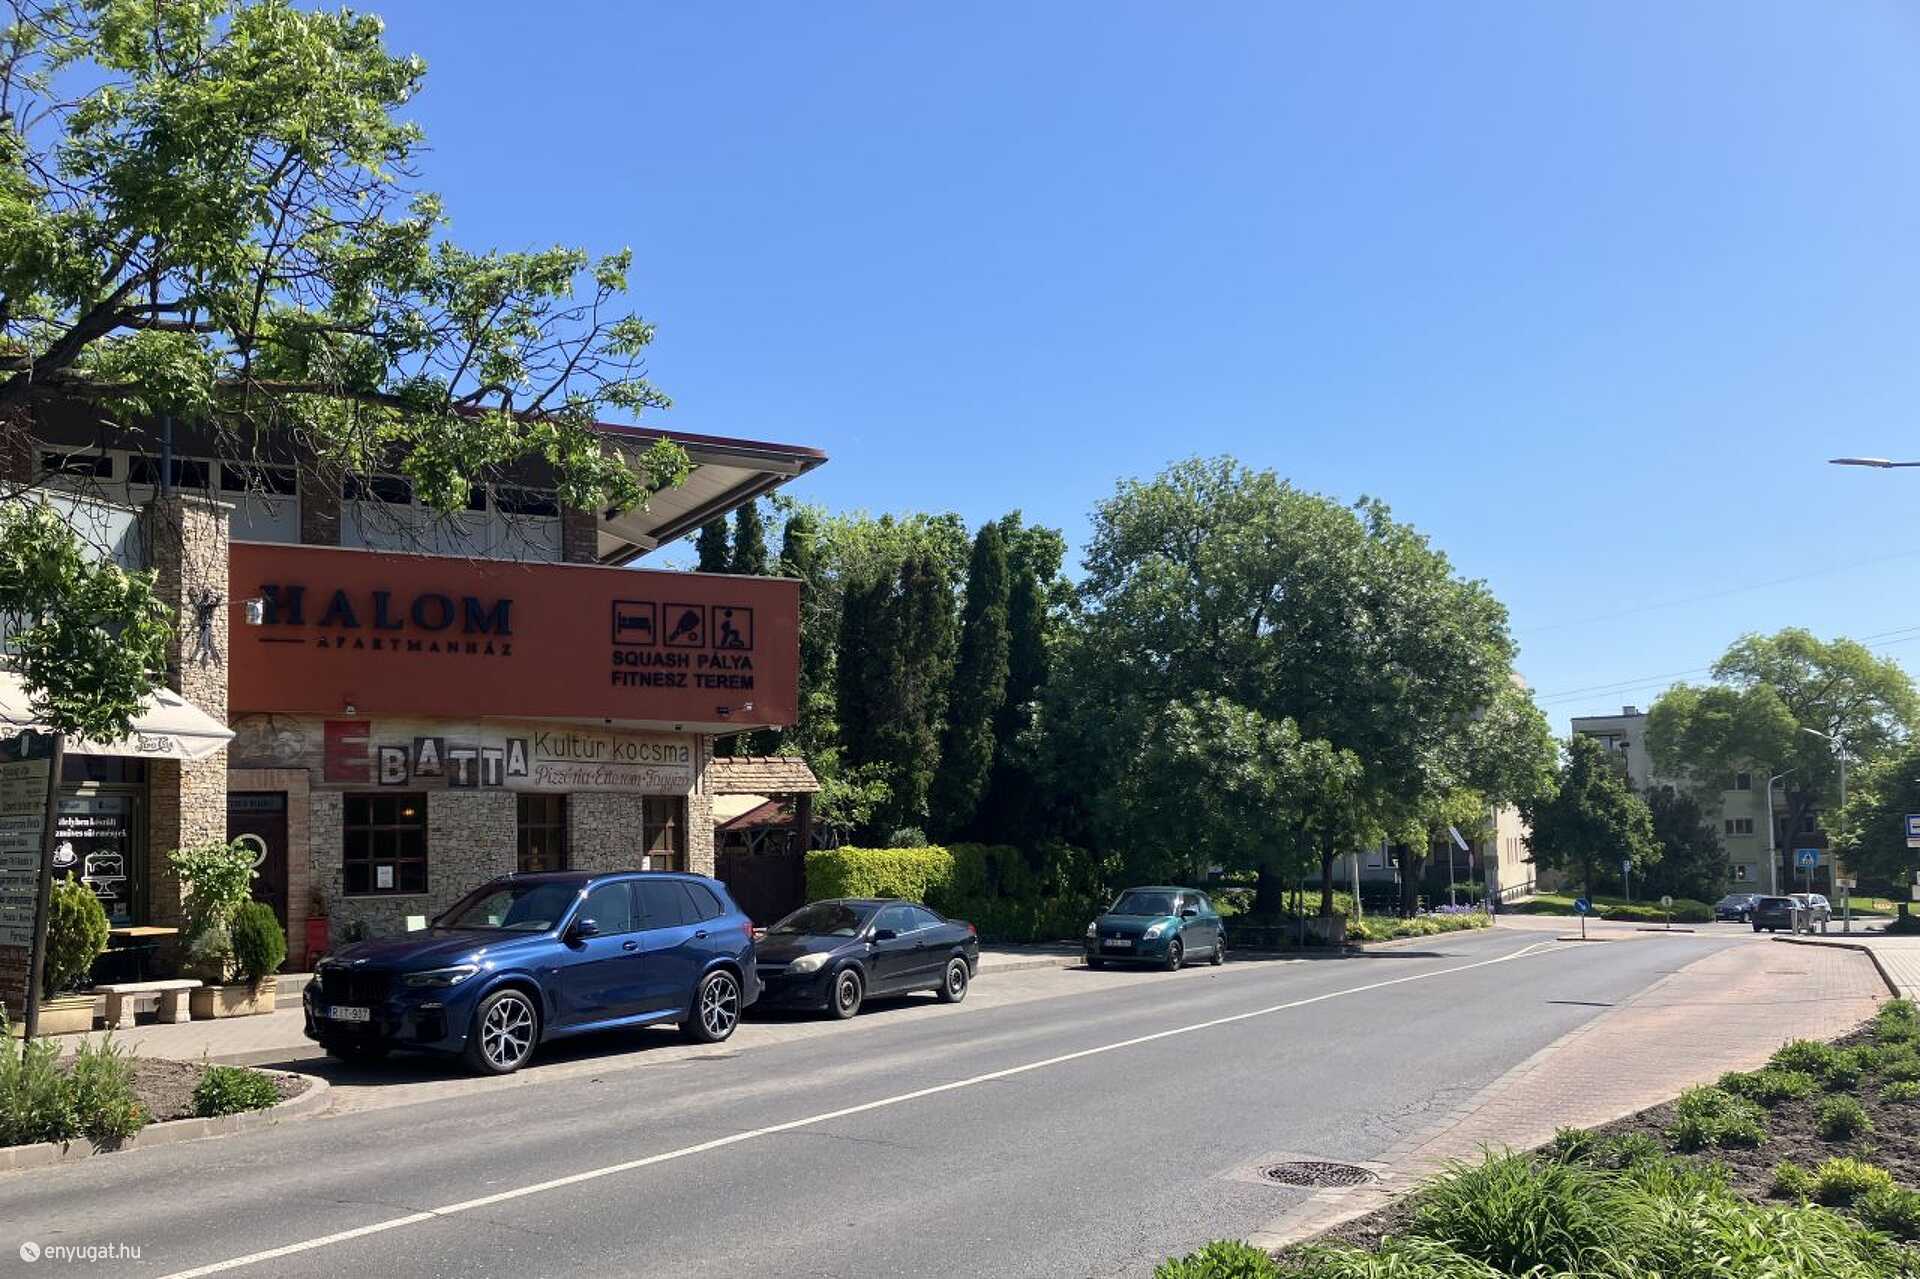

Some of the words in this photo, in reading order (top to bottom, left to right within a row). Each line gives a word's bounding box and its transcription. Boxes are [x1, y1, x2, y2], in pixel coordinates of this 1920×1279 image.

[259, 584, 514, 637] HALOM
[316, 636, 512, 656] APARTMANHÁZ
[612, 650, 689, 669] SQUASH
[697, 652, 753, 670] PÁLYA
[611, 671, 688, 688] FITNESZ
[693, 673, 754, 690] TEREM
[613, 735, 689, 763] kocsma
